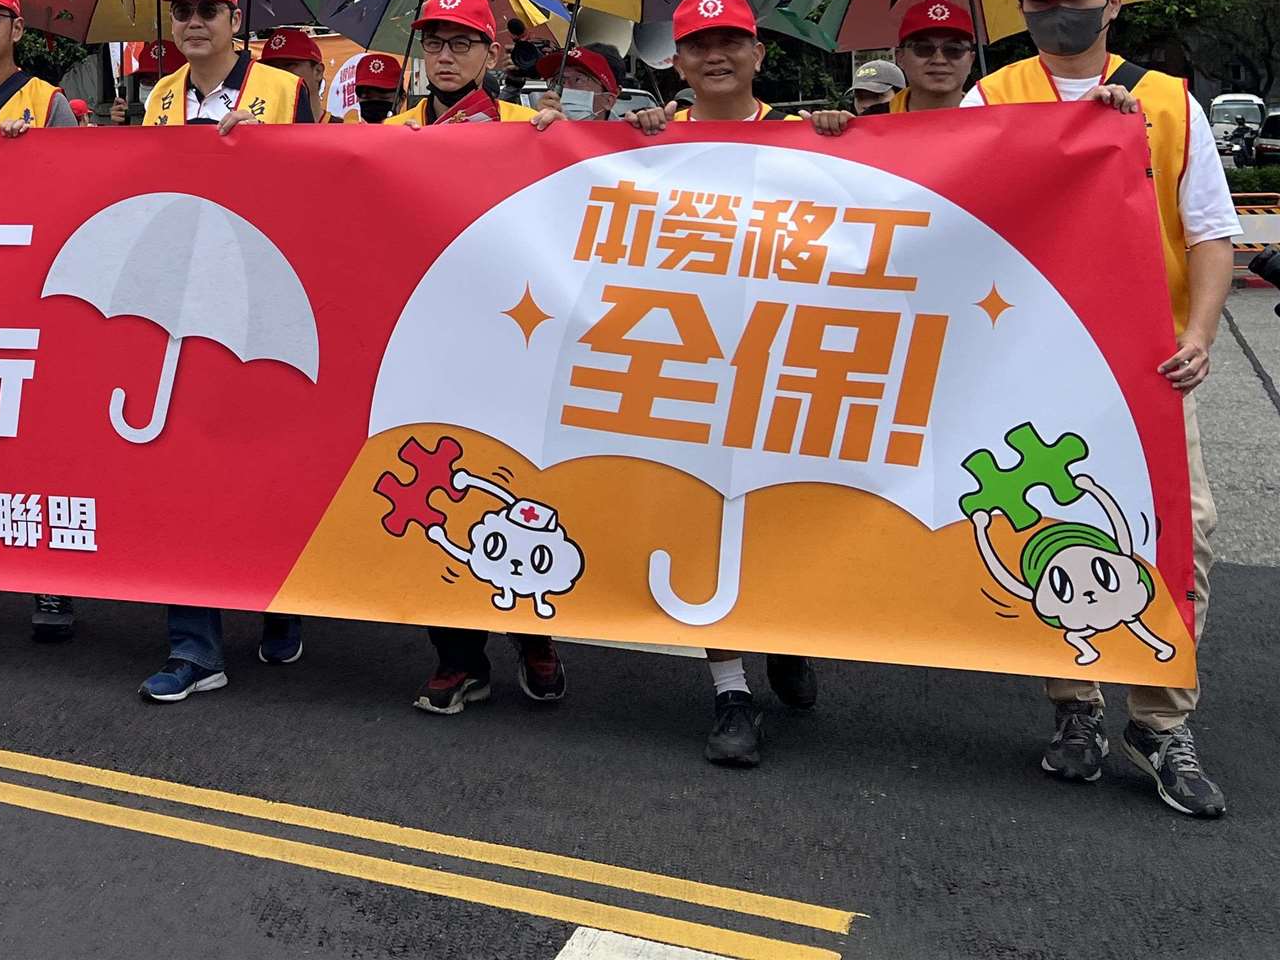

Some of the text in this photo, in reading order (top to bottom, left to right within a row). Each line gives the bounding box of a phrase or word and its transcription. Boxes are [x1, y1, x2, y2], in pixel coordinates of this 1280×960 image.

[219, 93, 236, 112] FIL
[572, 180, 931, 292] 本勞移工
[560, 284, 950, 468] 全保!
